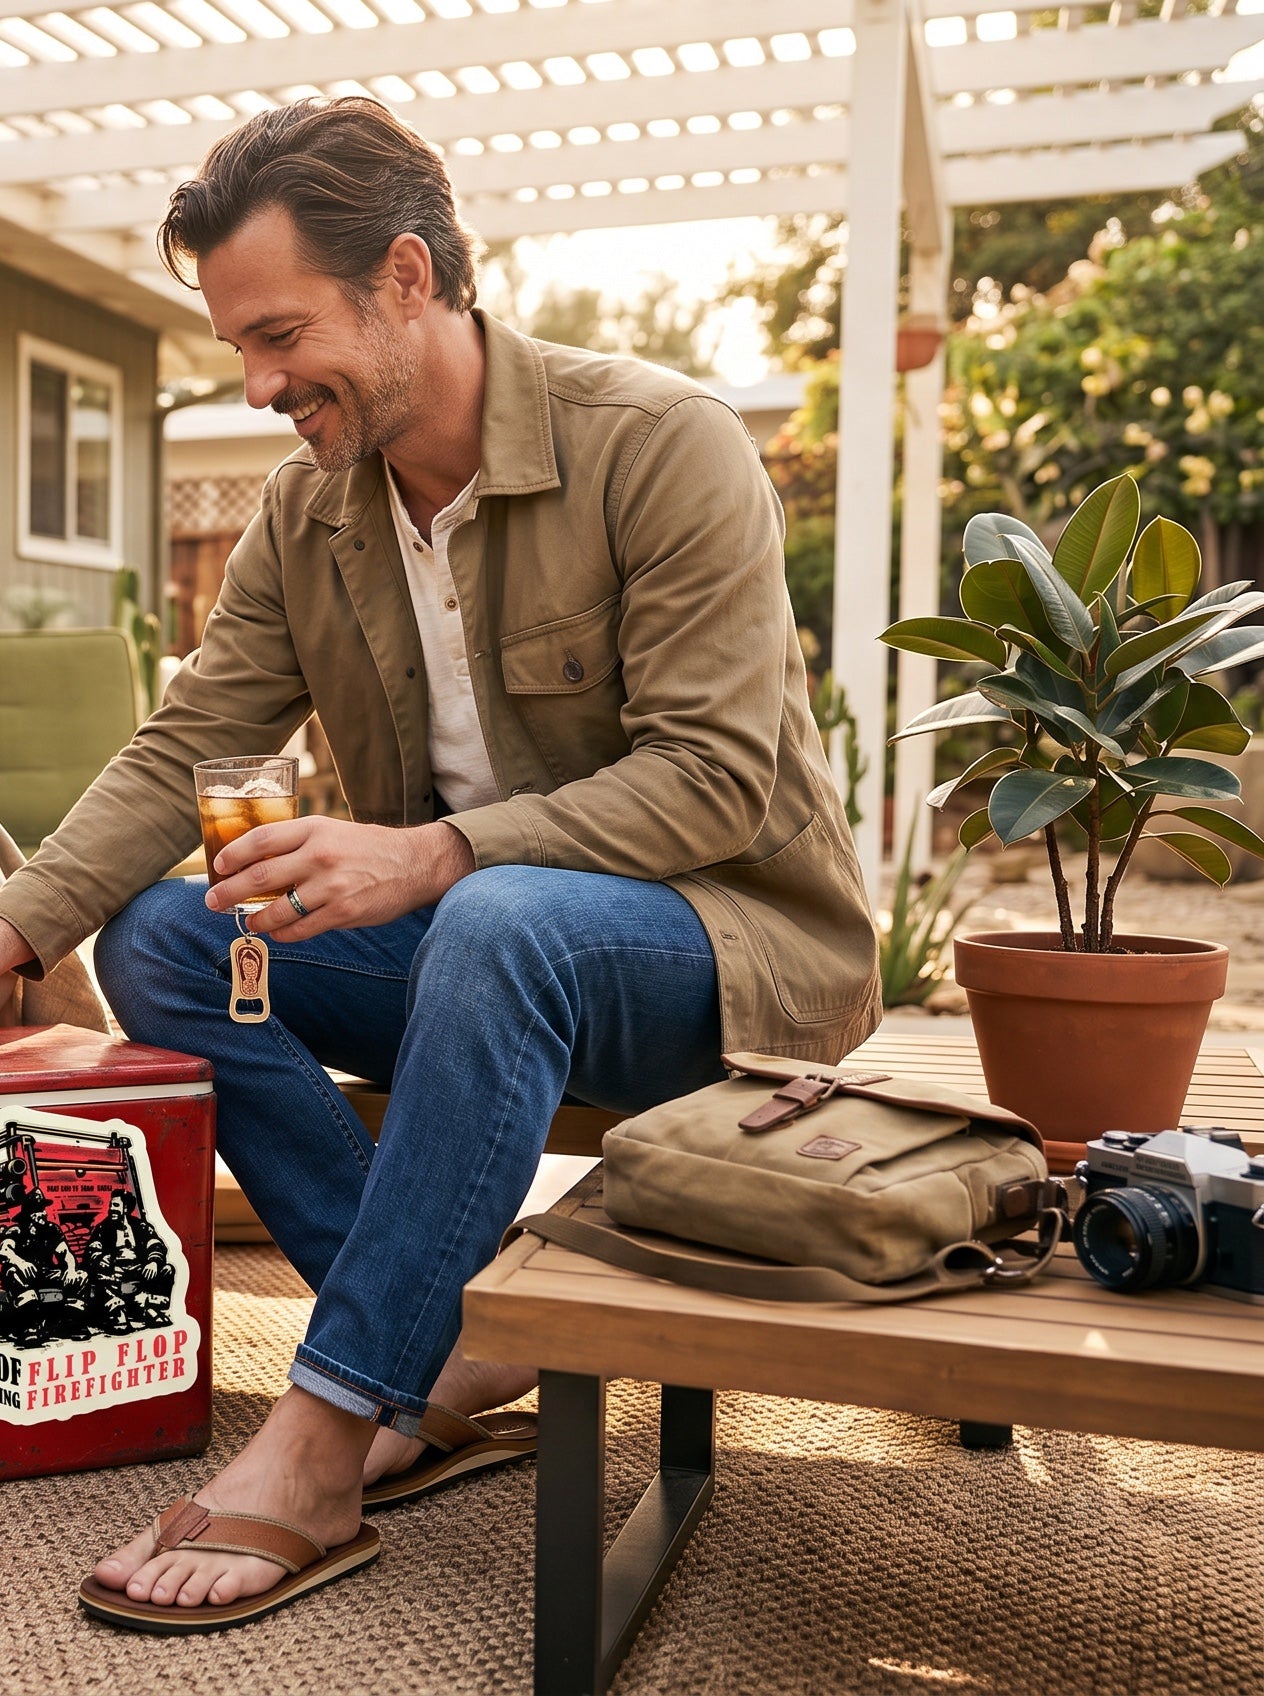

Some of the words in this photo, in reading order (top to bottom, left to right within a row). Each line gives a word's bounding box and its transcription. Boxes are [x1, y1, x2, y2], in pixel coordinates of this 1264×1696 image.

[26, 1357, 185, 1410] FIREFIGHTER
[28, 1350, 96, 1386] FLIP
[117, 1330, 188, 1367] FLOP
